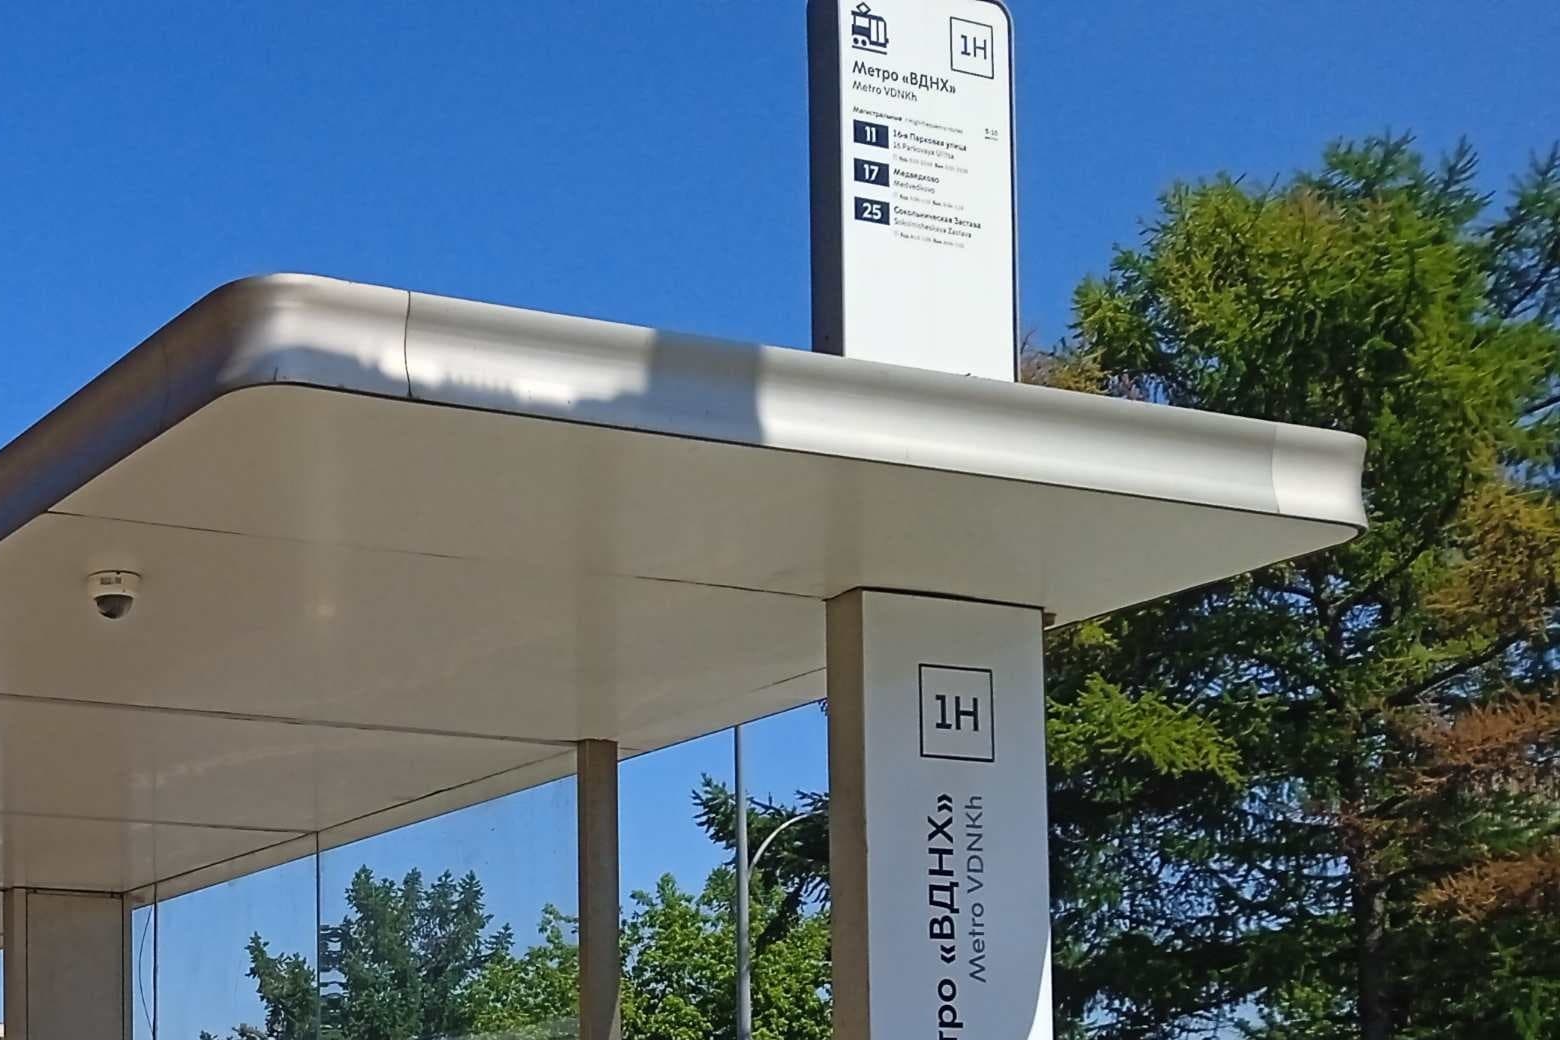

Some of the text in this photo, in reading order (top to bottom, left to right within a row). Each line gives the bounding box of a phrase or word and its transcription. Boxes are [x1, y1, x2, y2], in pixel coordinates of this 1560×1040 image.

[852, 60, 956, 94] Метро «ВДНХ»
[852, 80, 918, 102] Metro VDNKh
[863, 126, 877, 143] 11
[863, 164, 879, 181] 17
[862, 202, 882, 220] 25
[926, 791, 961, 964] «ВДНХ»
[963, 795, 987, 984] Metro VDNKh
